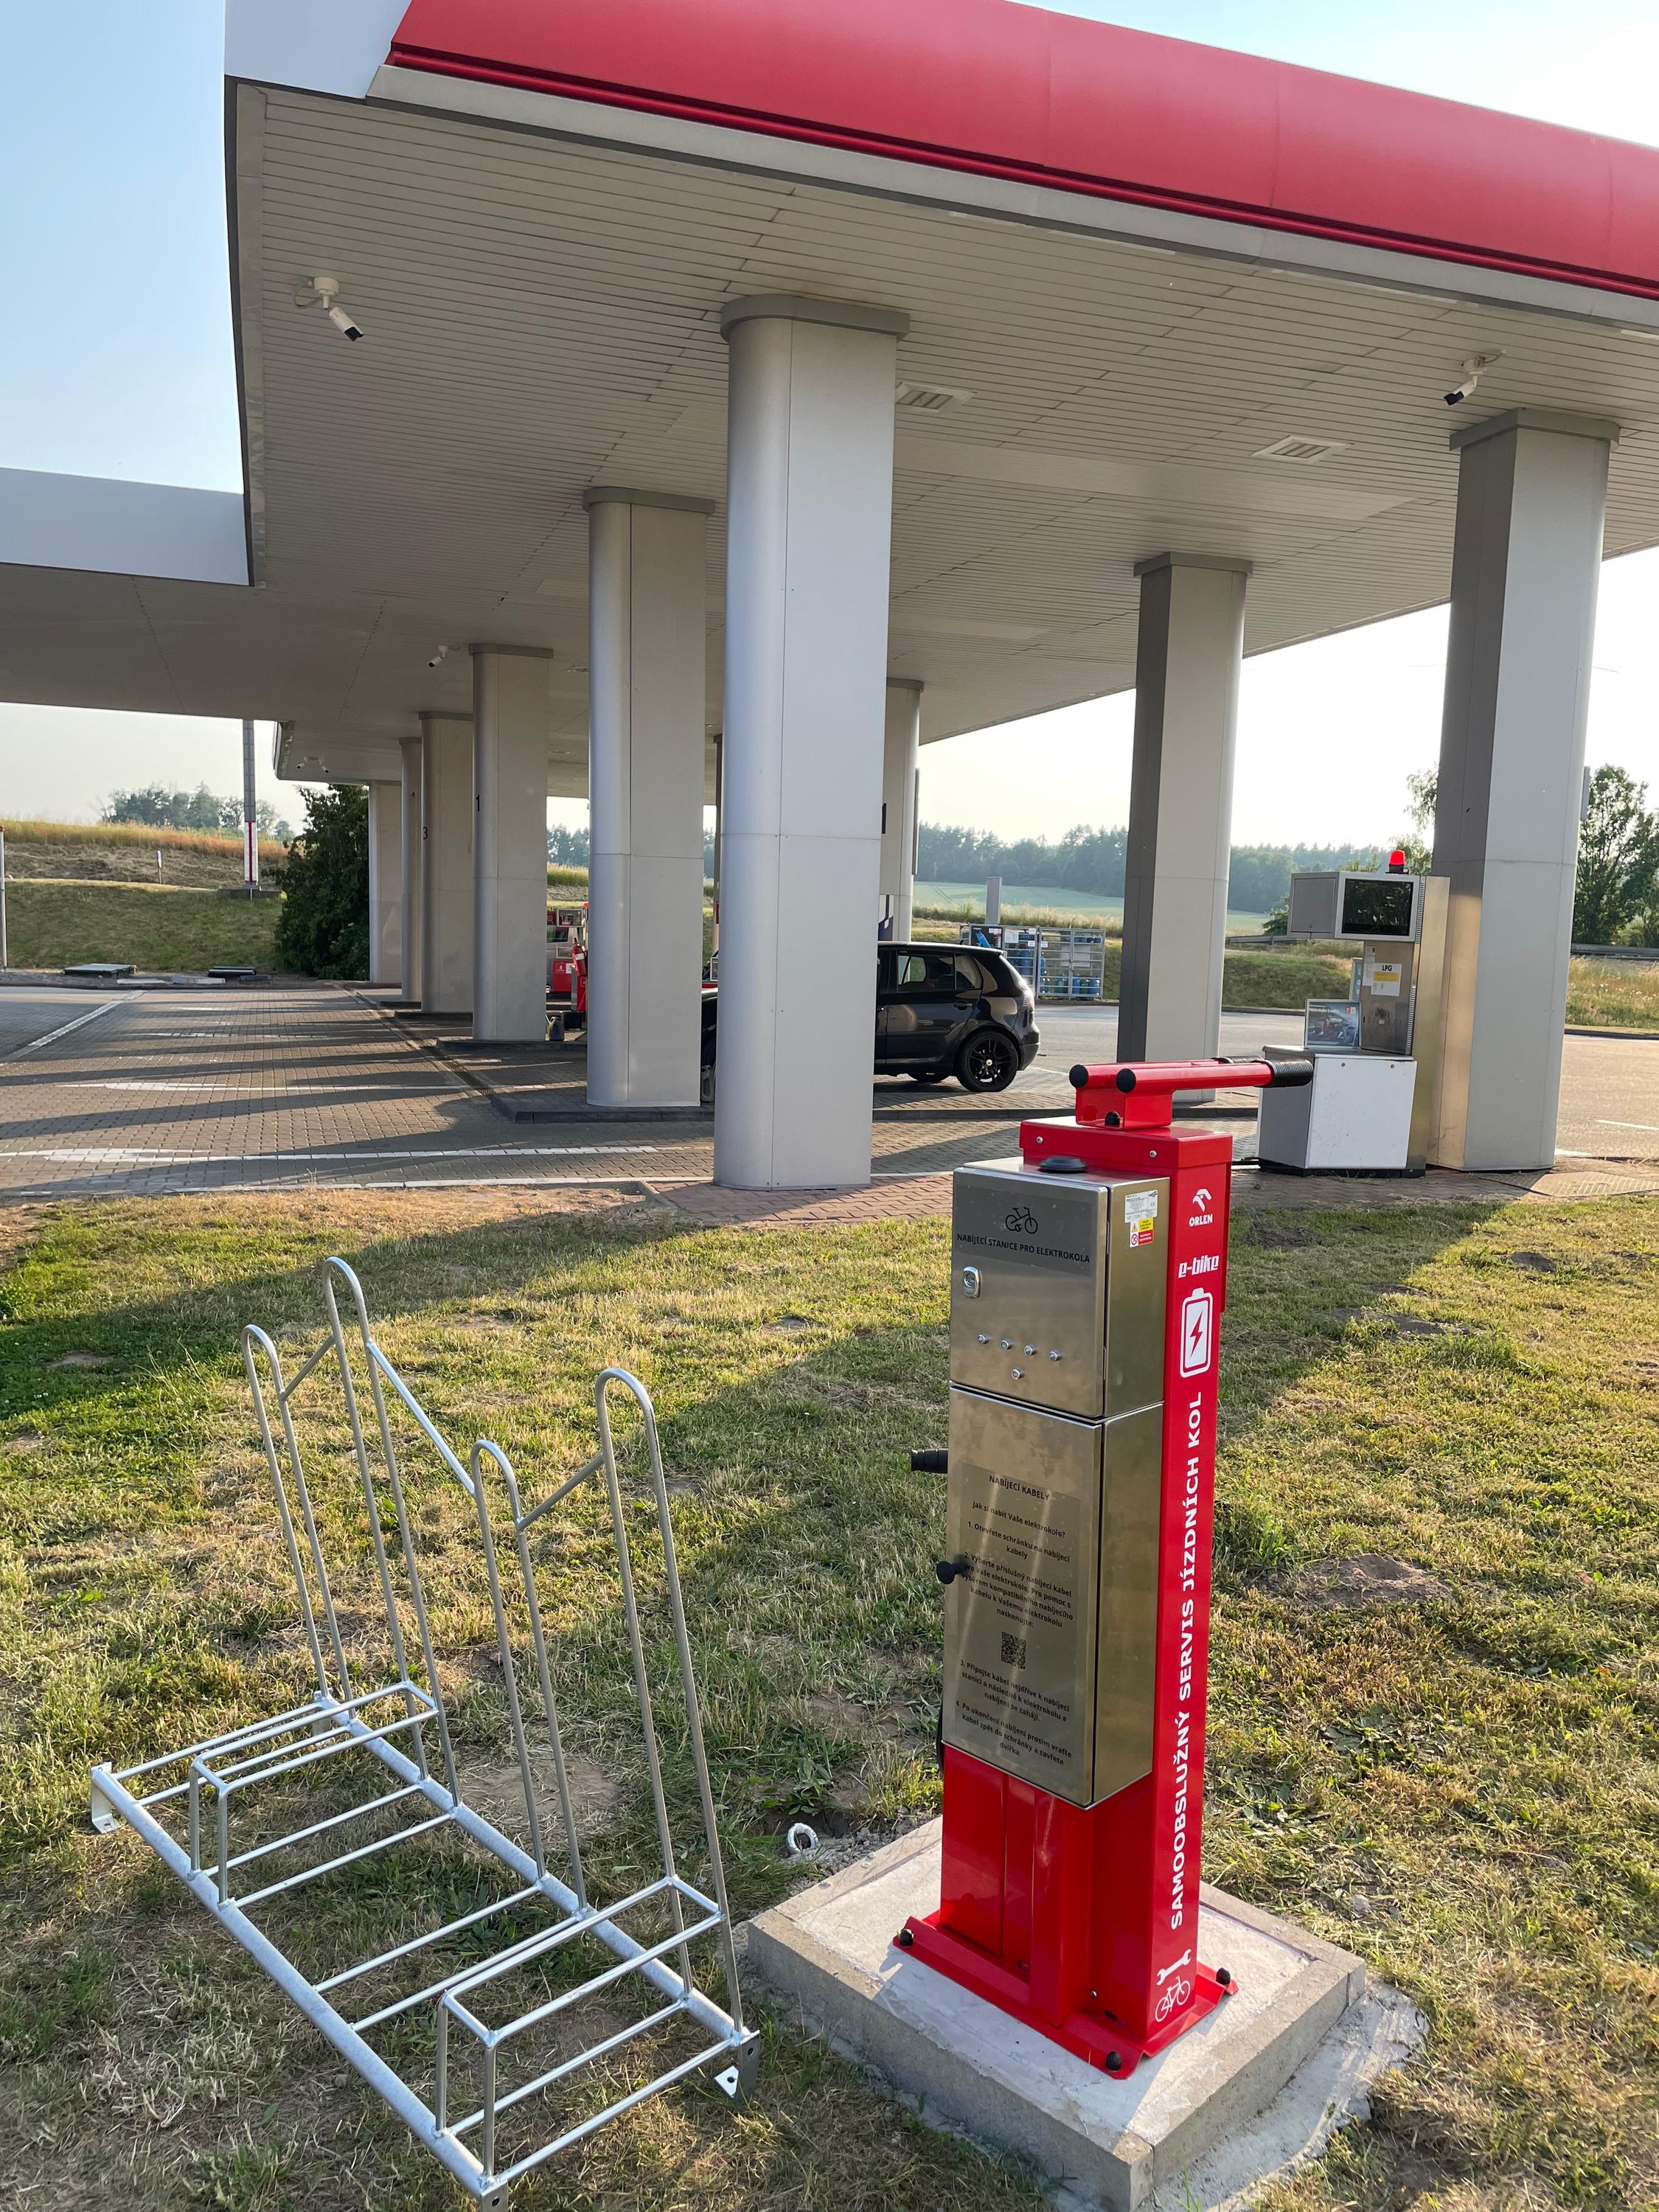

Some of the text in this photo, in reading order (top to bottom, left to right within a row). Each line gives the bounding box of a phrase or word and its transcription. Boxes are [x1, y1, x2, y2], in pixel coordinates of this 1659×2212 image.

[422, 826, 428, 840] 3
[1189, 1214, 1213, 1227] ORLEN
[957, 1234, 1091, 1263] NABÍJECÍ STANICE PRO ELEKTROKOLA
[1178, 1255, 1220, 1279] e-bike
[989, 1475, 1049, 1500] NABÍJECÍ KABELY
[973, 1500, 983, 1510] Jak
[1008, 1513, 1023, 1524] Vaše
[1024, 1519, 1065, 1538] elektrokolo?
[974, 1523, 1002, 1538] Otevřete
[1003, 1534, 1032, 1549] schránku
[1043, 1547, 1070, 1562] nabíjecí
[1006, 1545, 1028, 1560] kabely
[971, 1554, 995, 1568] Vyberte
[1053, 1585, 1071, 1597] kabel
[975, 1567, 991, 1578] Vaše
[1043, 1593, 1066, 1607] pomoc
[970, 1586, 1062, 1627] kabelu k Vašemu elektrokolu
[1171, 1392, 1202, 1930] SAMOOBSLUŽNÝ SERVIS JÍZDNÍCH KOL
[992, 1672, 1009, 1686] kabel
[1023, 1698, 1061, 1719] elektrokolu
[961, 1713, 979, 1726] kabel
[994, 1728, 1003, 1736] do
[962, 1703, 970, 1711] Po
[1027, 1733, 1050, 1748] prosím
